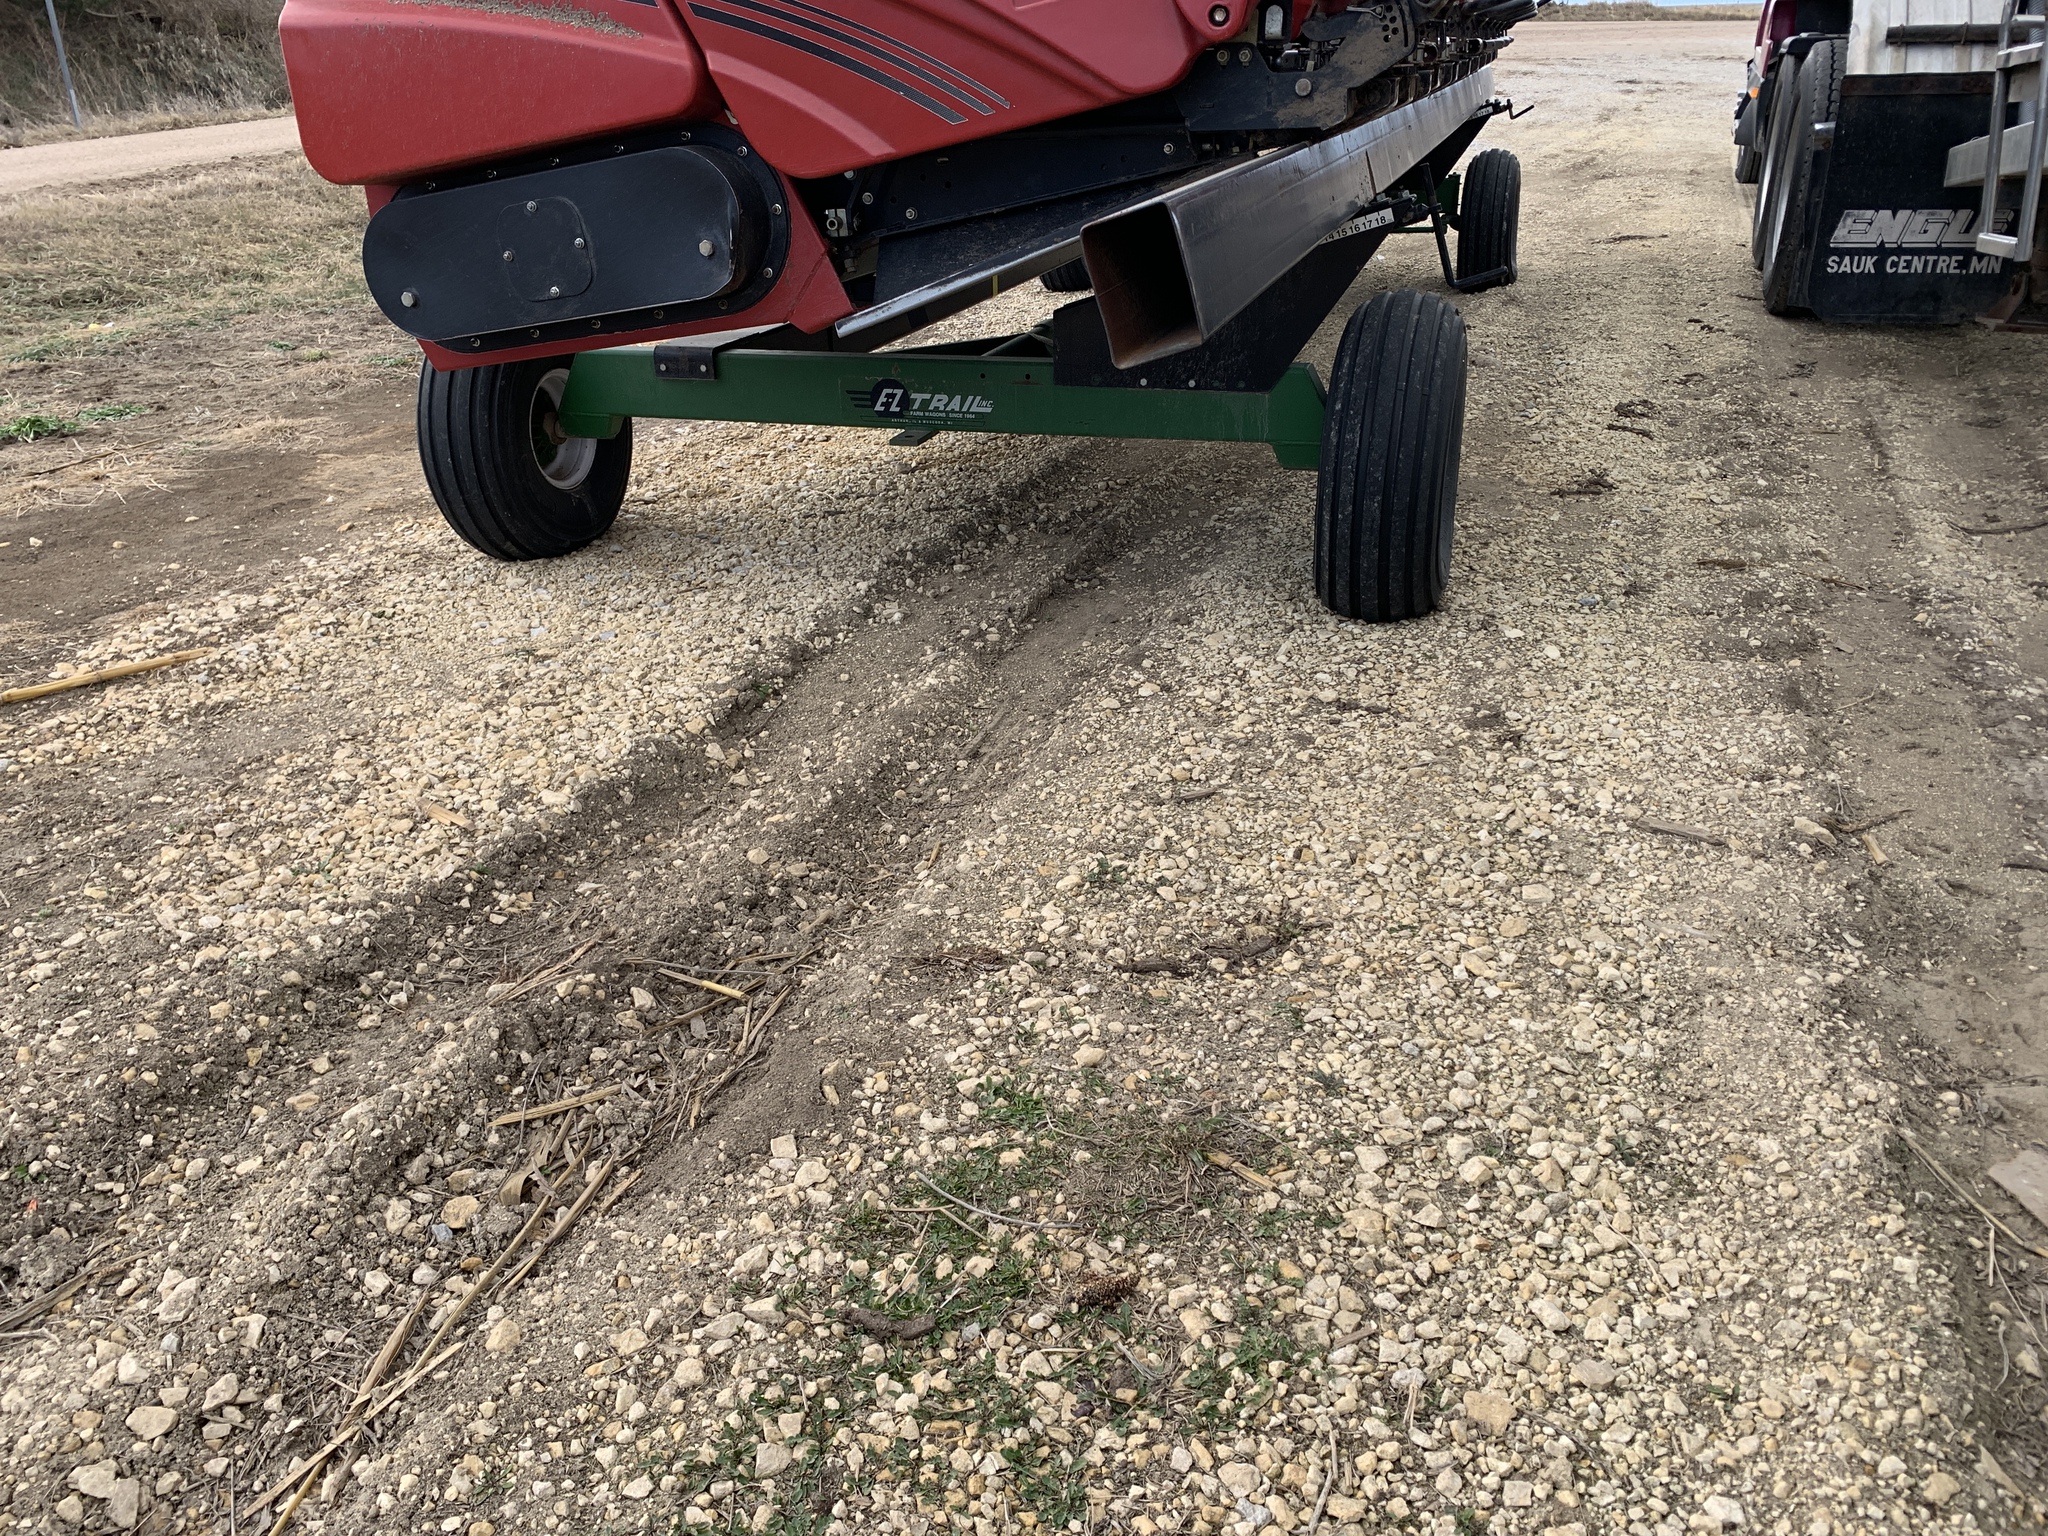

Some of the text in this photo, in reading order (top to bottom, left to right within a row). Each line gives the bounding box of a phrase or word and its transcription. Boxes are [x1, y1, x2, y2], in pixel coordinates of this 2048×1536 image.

[1336, 228, 1348, 238] 15
[1349, 224, 1361, 233] 16
[1362, 220, 1373, 230] 17
[1375, 216, 1387, 226] 18
[1826, 255, 1878, 274] SAUK
[910, 393, 993, 413] TRAIL
